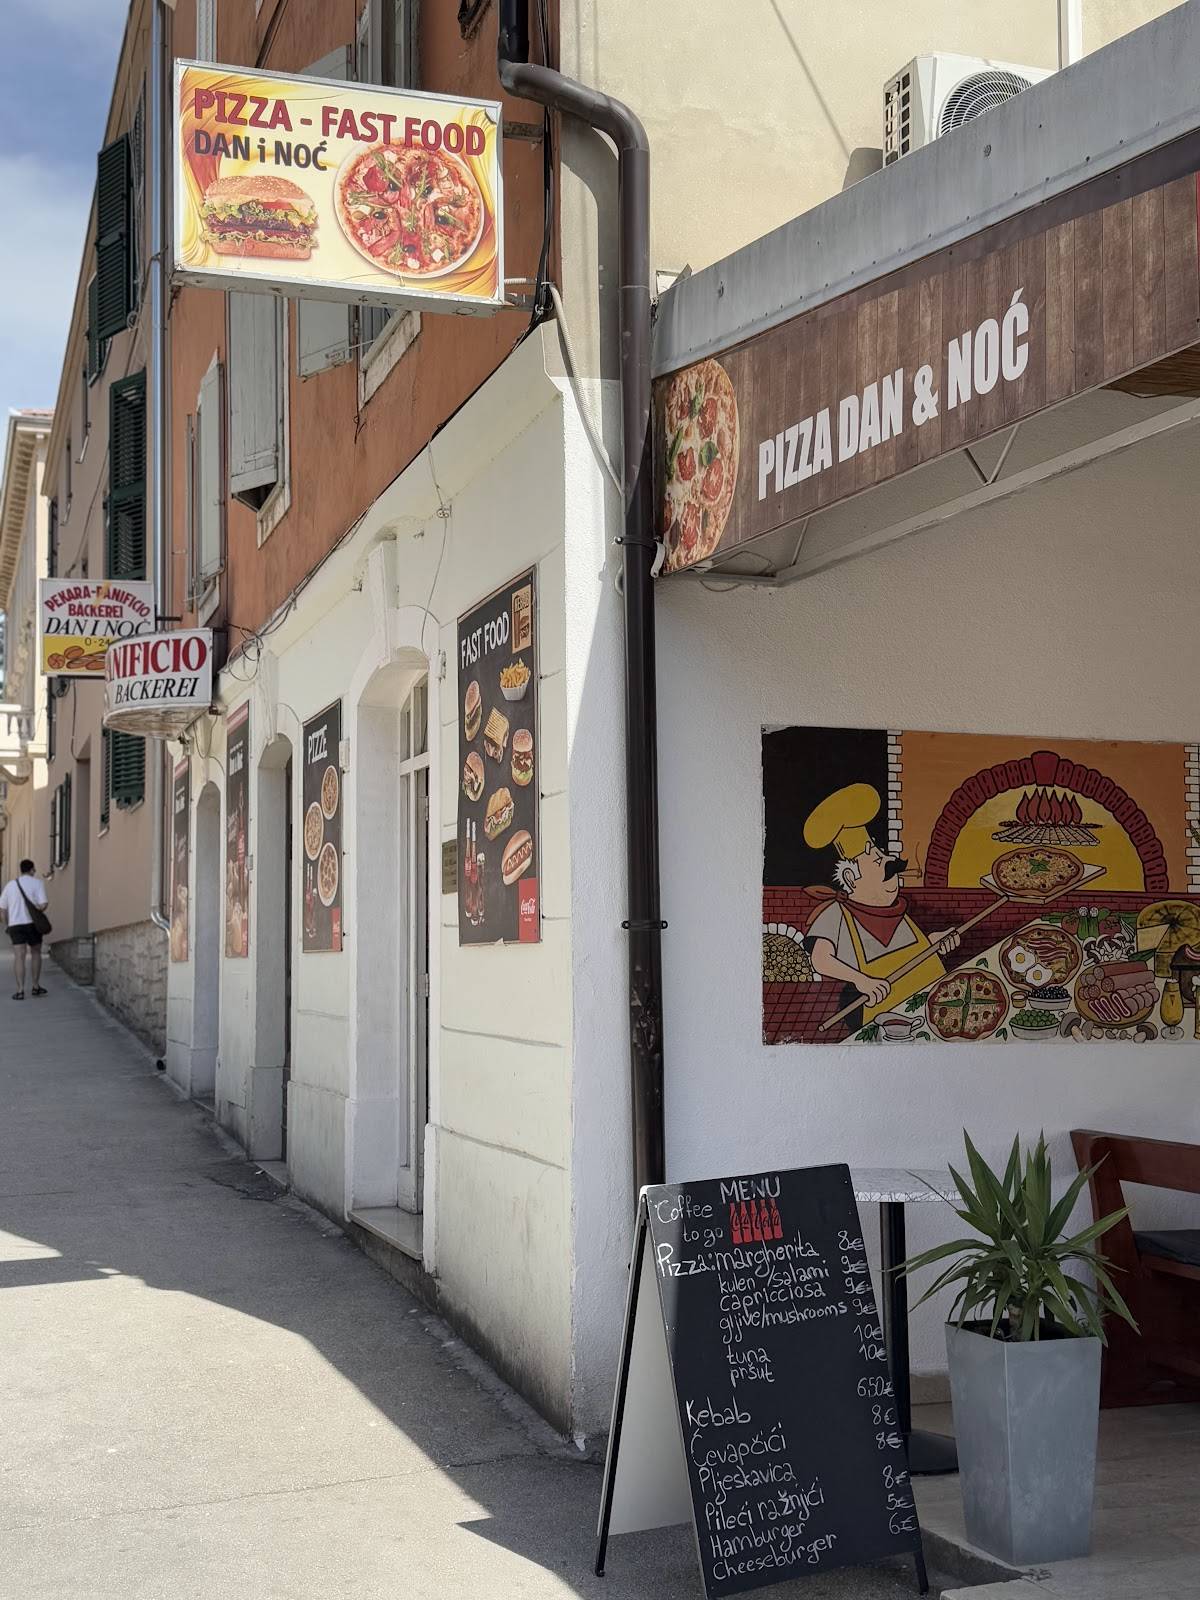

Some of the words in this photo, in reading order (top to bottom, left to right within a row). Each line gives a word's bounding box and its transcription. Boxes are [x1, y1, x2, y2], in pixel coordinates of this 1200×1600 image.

[194, 88, 293, 132] PIZZA
[321, 106, 397, 146] FAST
[404, 118, 486, 156] FOOD
[194, 129, 250, 162] DAN
[258, 138, 266, 163] i
[274, 140, 328, 171] NOĆ
[758, 407, 832, 501] PIZZA
[839, 368, 904, 463] DAN
[912, 364, 939, 426] &
[947, 287, 1029, 411] NOĆ
[45, 617, 88, 635] DAN
[461, 627, 482, 669] FAST
[484, 611, 509, 655] FOOD
[308, 724, 328, 765] PIZZE
[719, 1177, 781, 1204] MENU
[654, 1195, 714, 1223] Coffee
[683, 1224, 700, 1242] to
[703, 1227, 724, 1247] go
[716, 1229, 820, 1277] margherita
[718, 1273, 756, 1294] kulen
[720, 1283, 826, 1313] capricciosa
[727, 1345, 771, 1365] tuna
[685, 1396, 751, 1428] Kebab
[699, 1462, 797, 1505] Pljeskavica
[705, 1500, 753, 1531] Pileći
[710, 1521, 806, 1559] Hamburger
[713, 1533, 837, 1580] Cheeseburger
